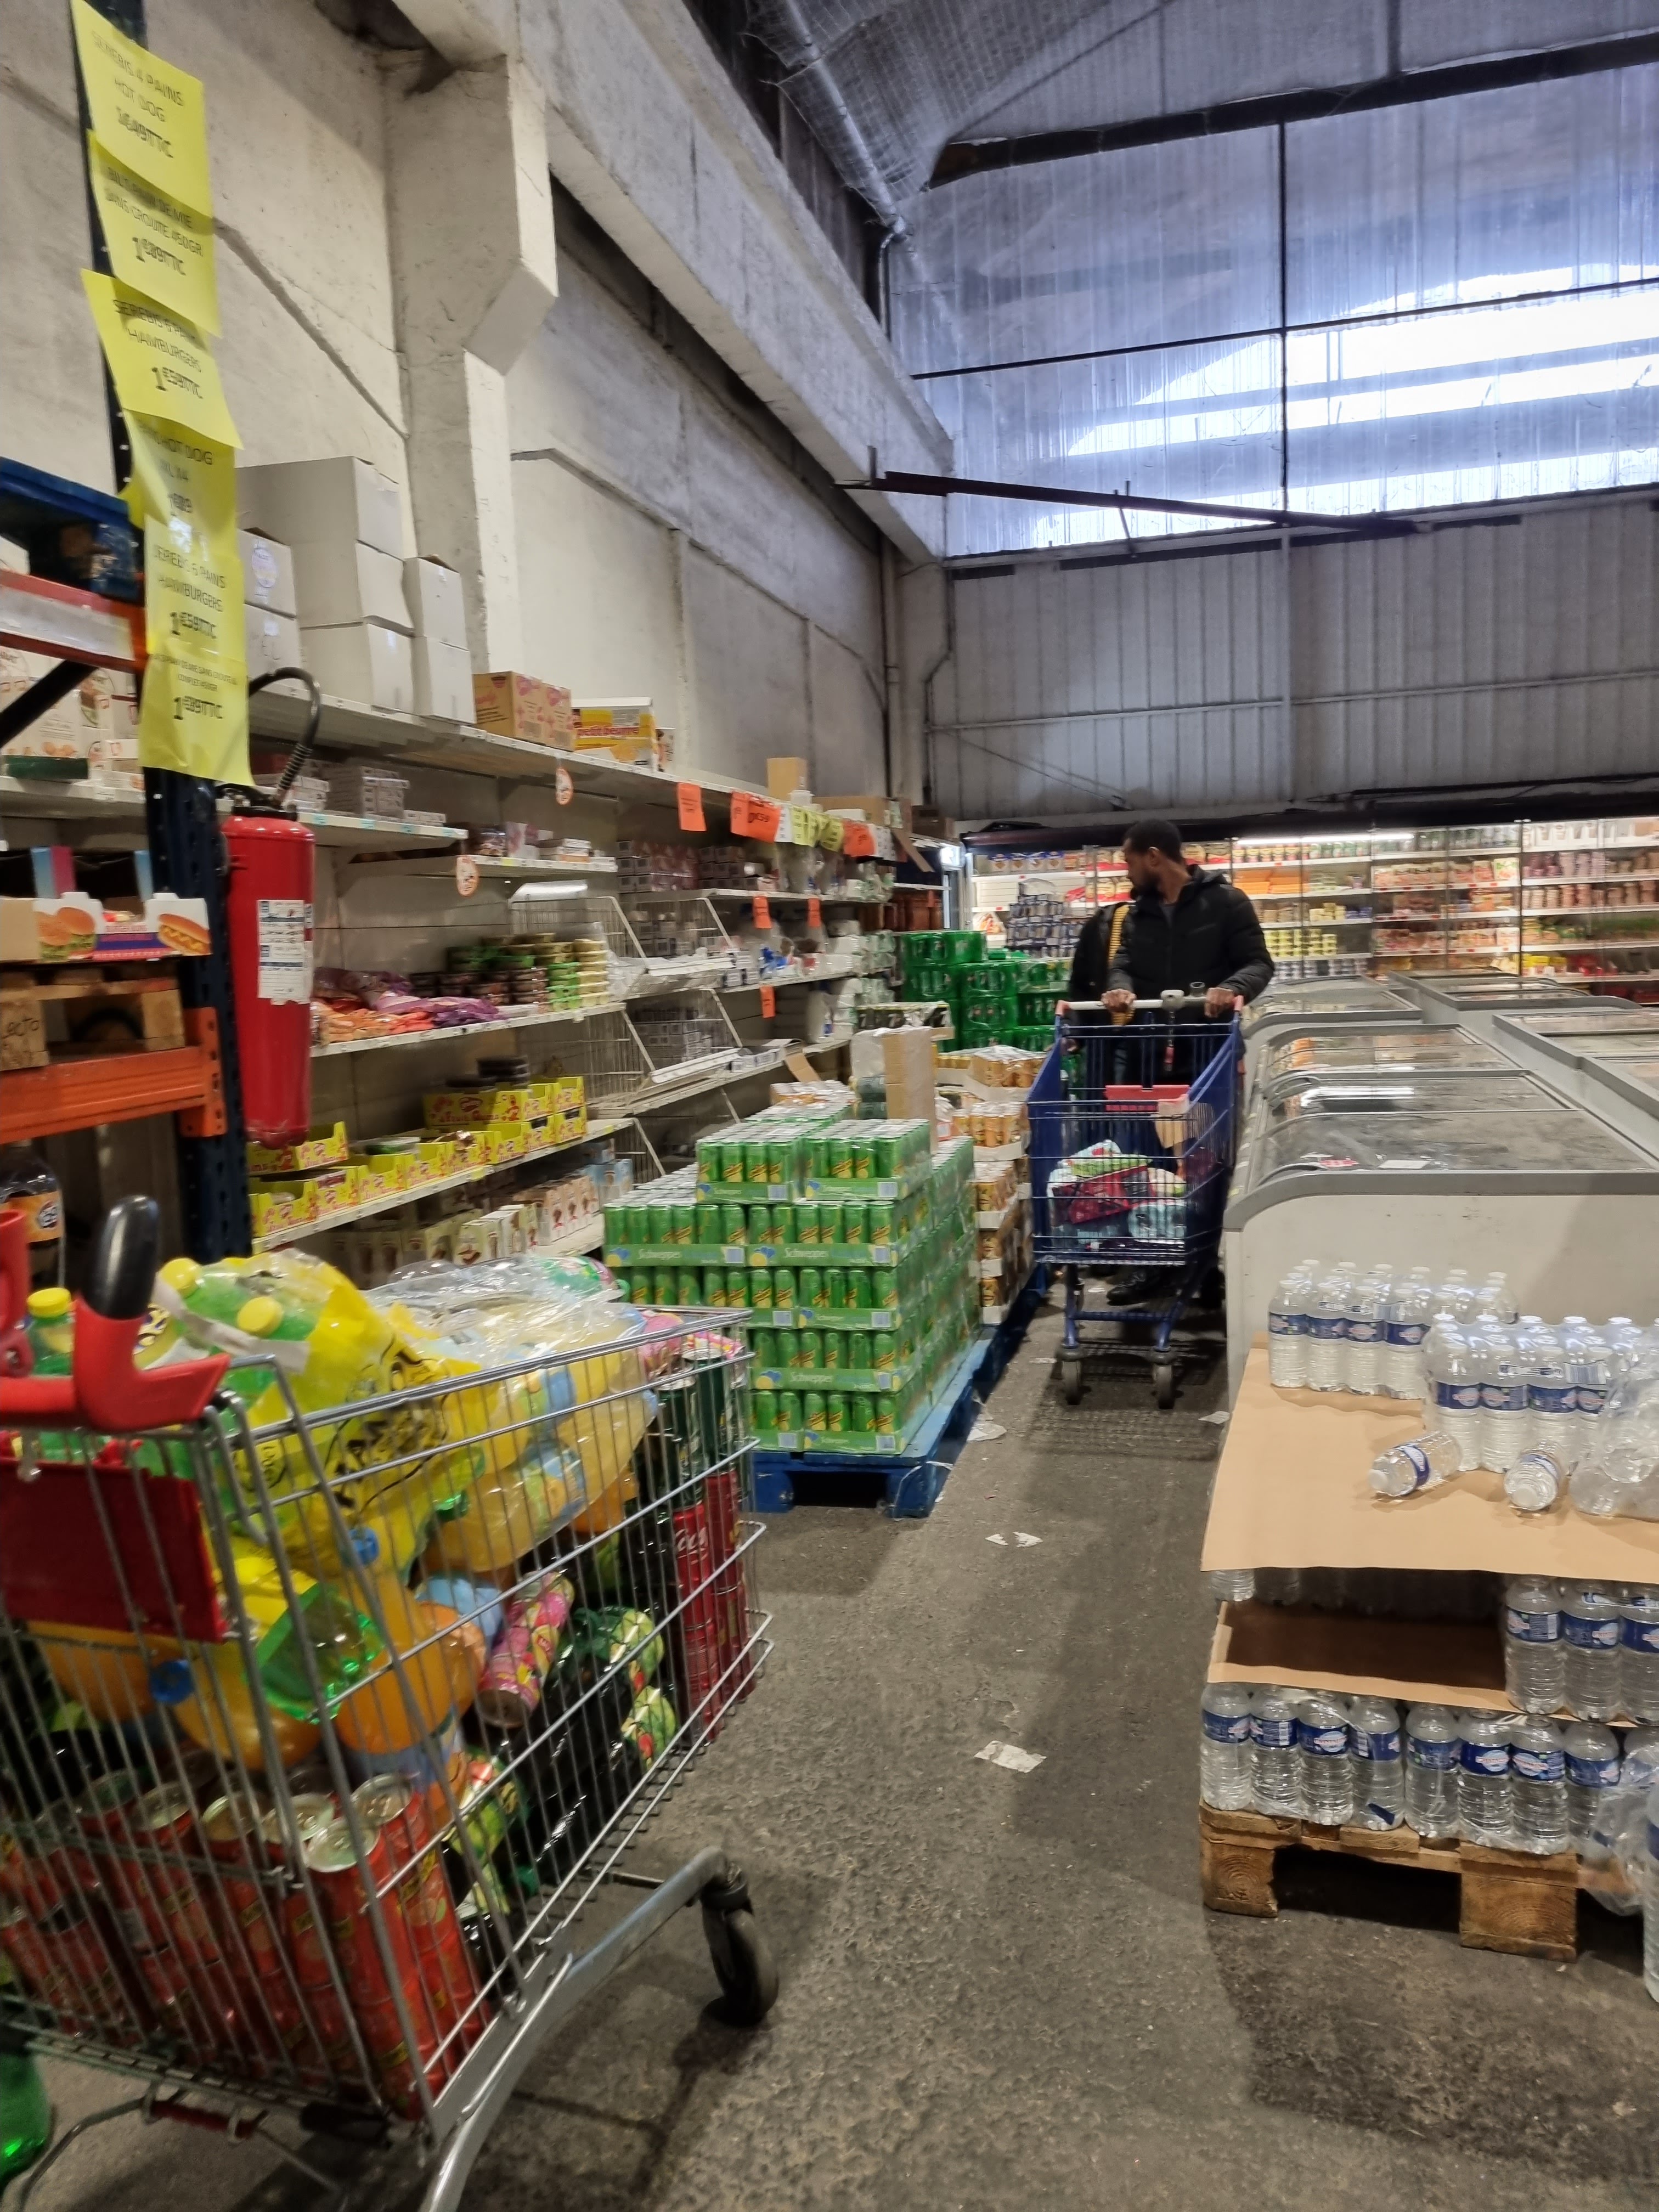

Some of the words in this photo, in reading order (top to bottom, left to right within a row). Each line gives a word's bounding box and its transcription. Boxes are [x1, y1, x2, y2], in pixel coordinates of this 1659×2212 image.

[146, 74, 184, 107] PAINS
[139, 95, 166, 122] DOG
[131, 206, 170, 239] CROUTE
[173, 208, 193, 229] MIE
[185, 445, 213, 465] DOG
[200, 566, 226, 589] PAINS
